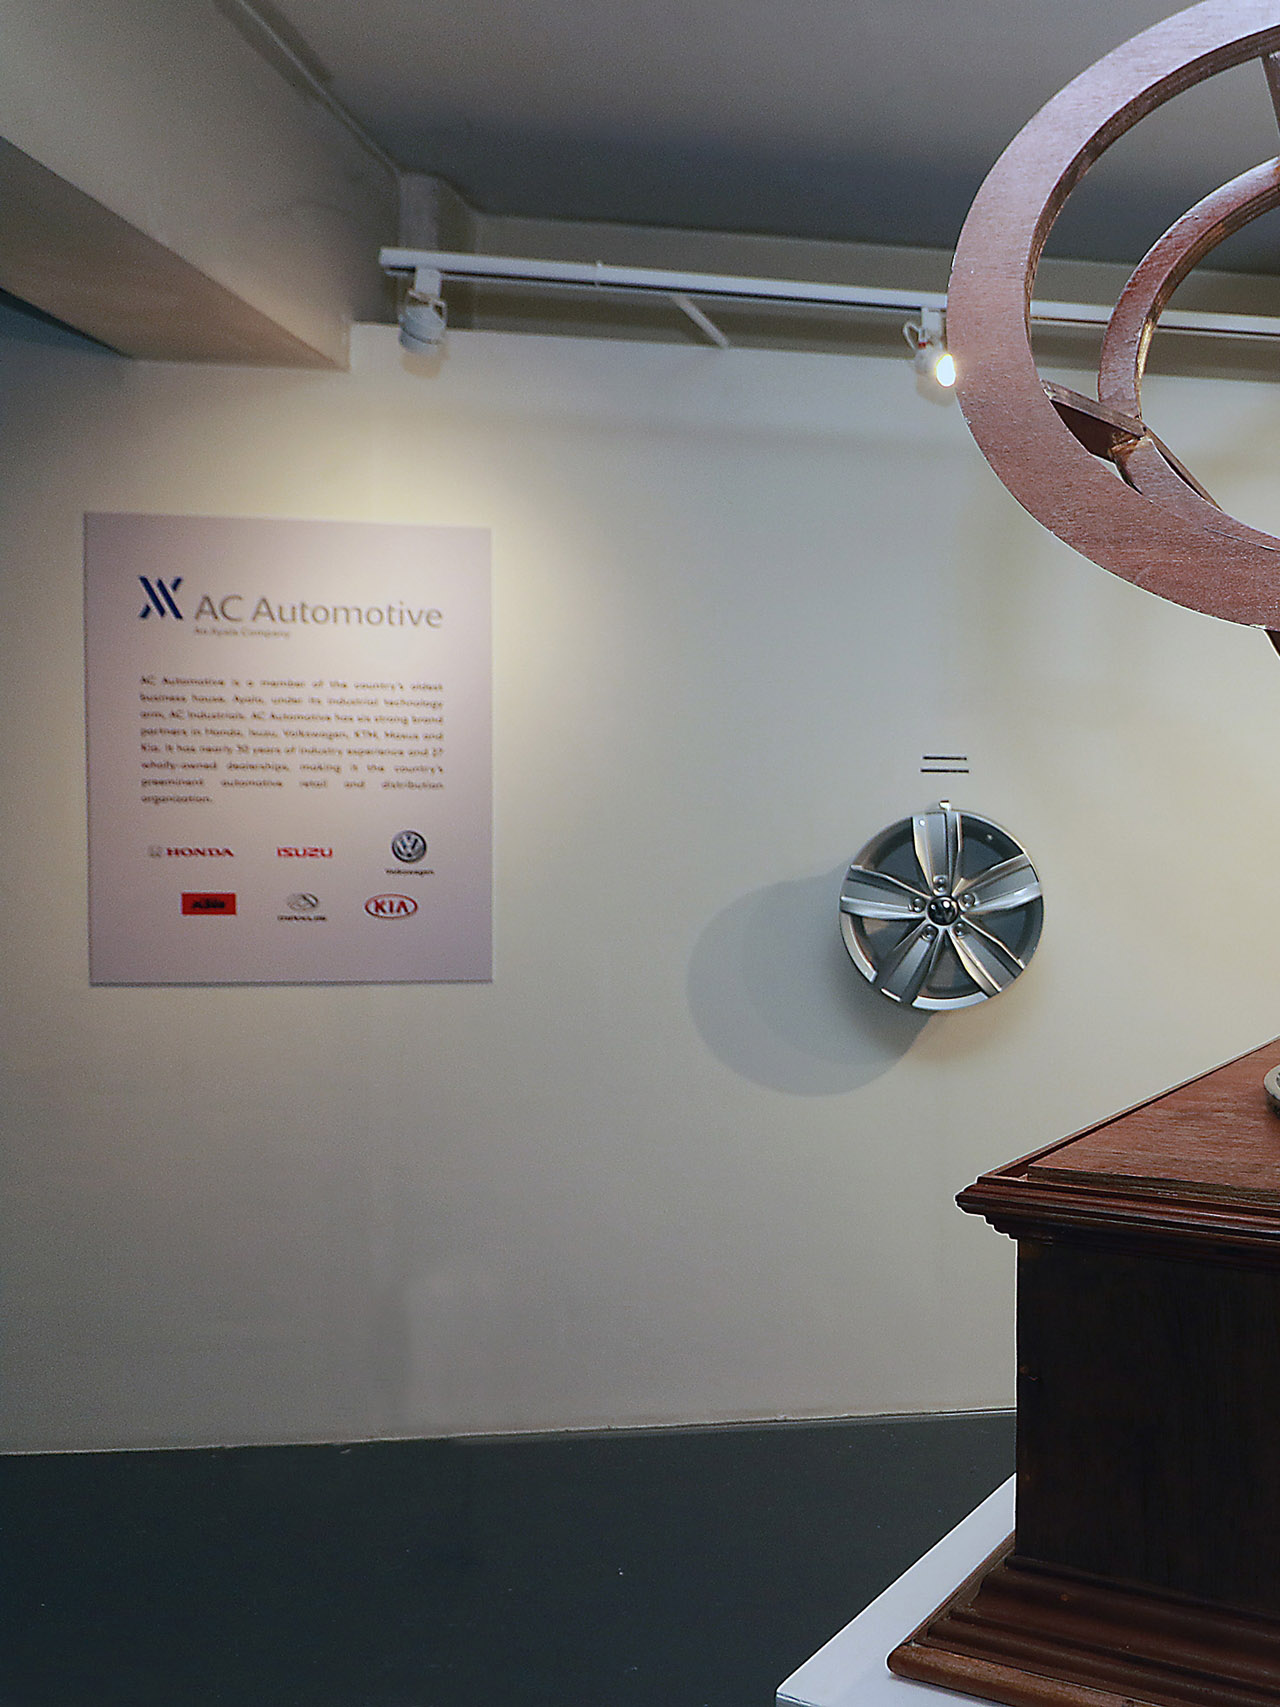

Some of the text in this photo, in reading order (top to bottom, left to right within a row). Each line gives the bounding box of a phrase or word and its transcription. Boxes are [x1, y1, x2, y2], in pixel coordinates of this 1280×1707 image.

[195, 594, 444, 629] AC Automotive
[166, 847, 235, 857] HONDA
[277, 847, 334, 858] ISUZU
[372, 899, 410, 914] KIA
